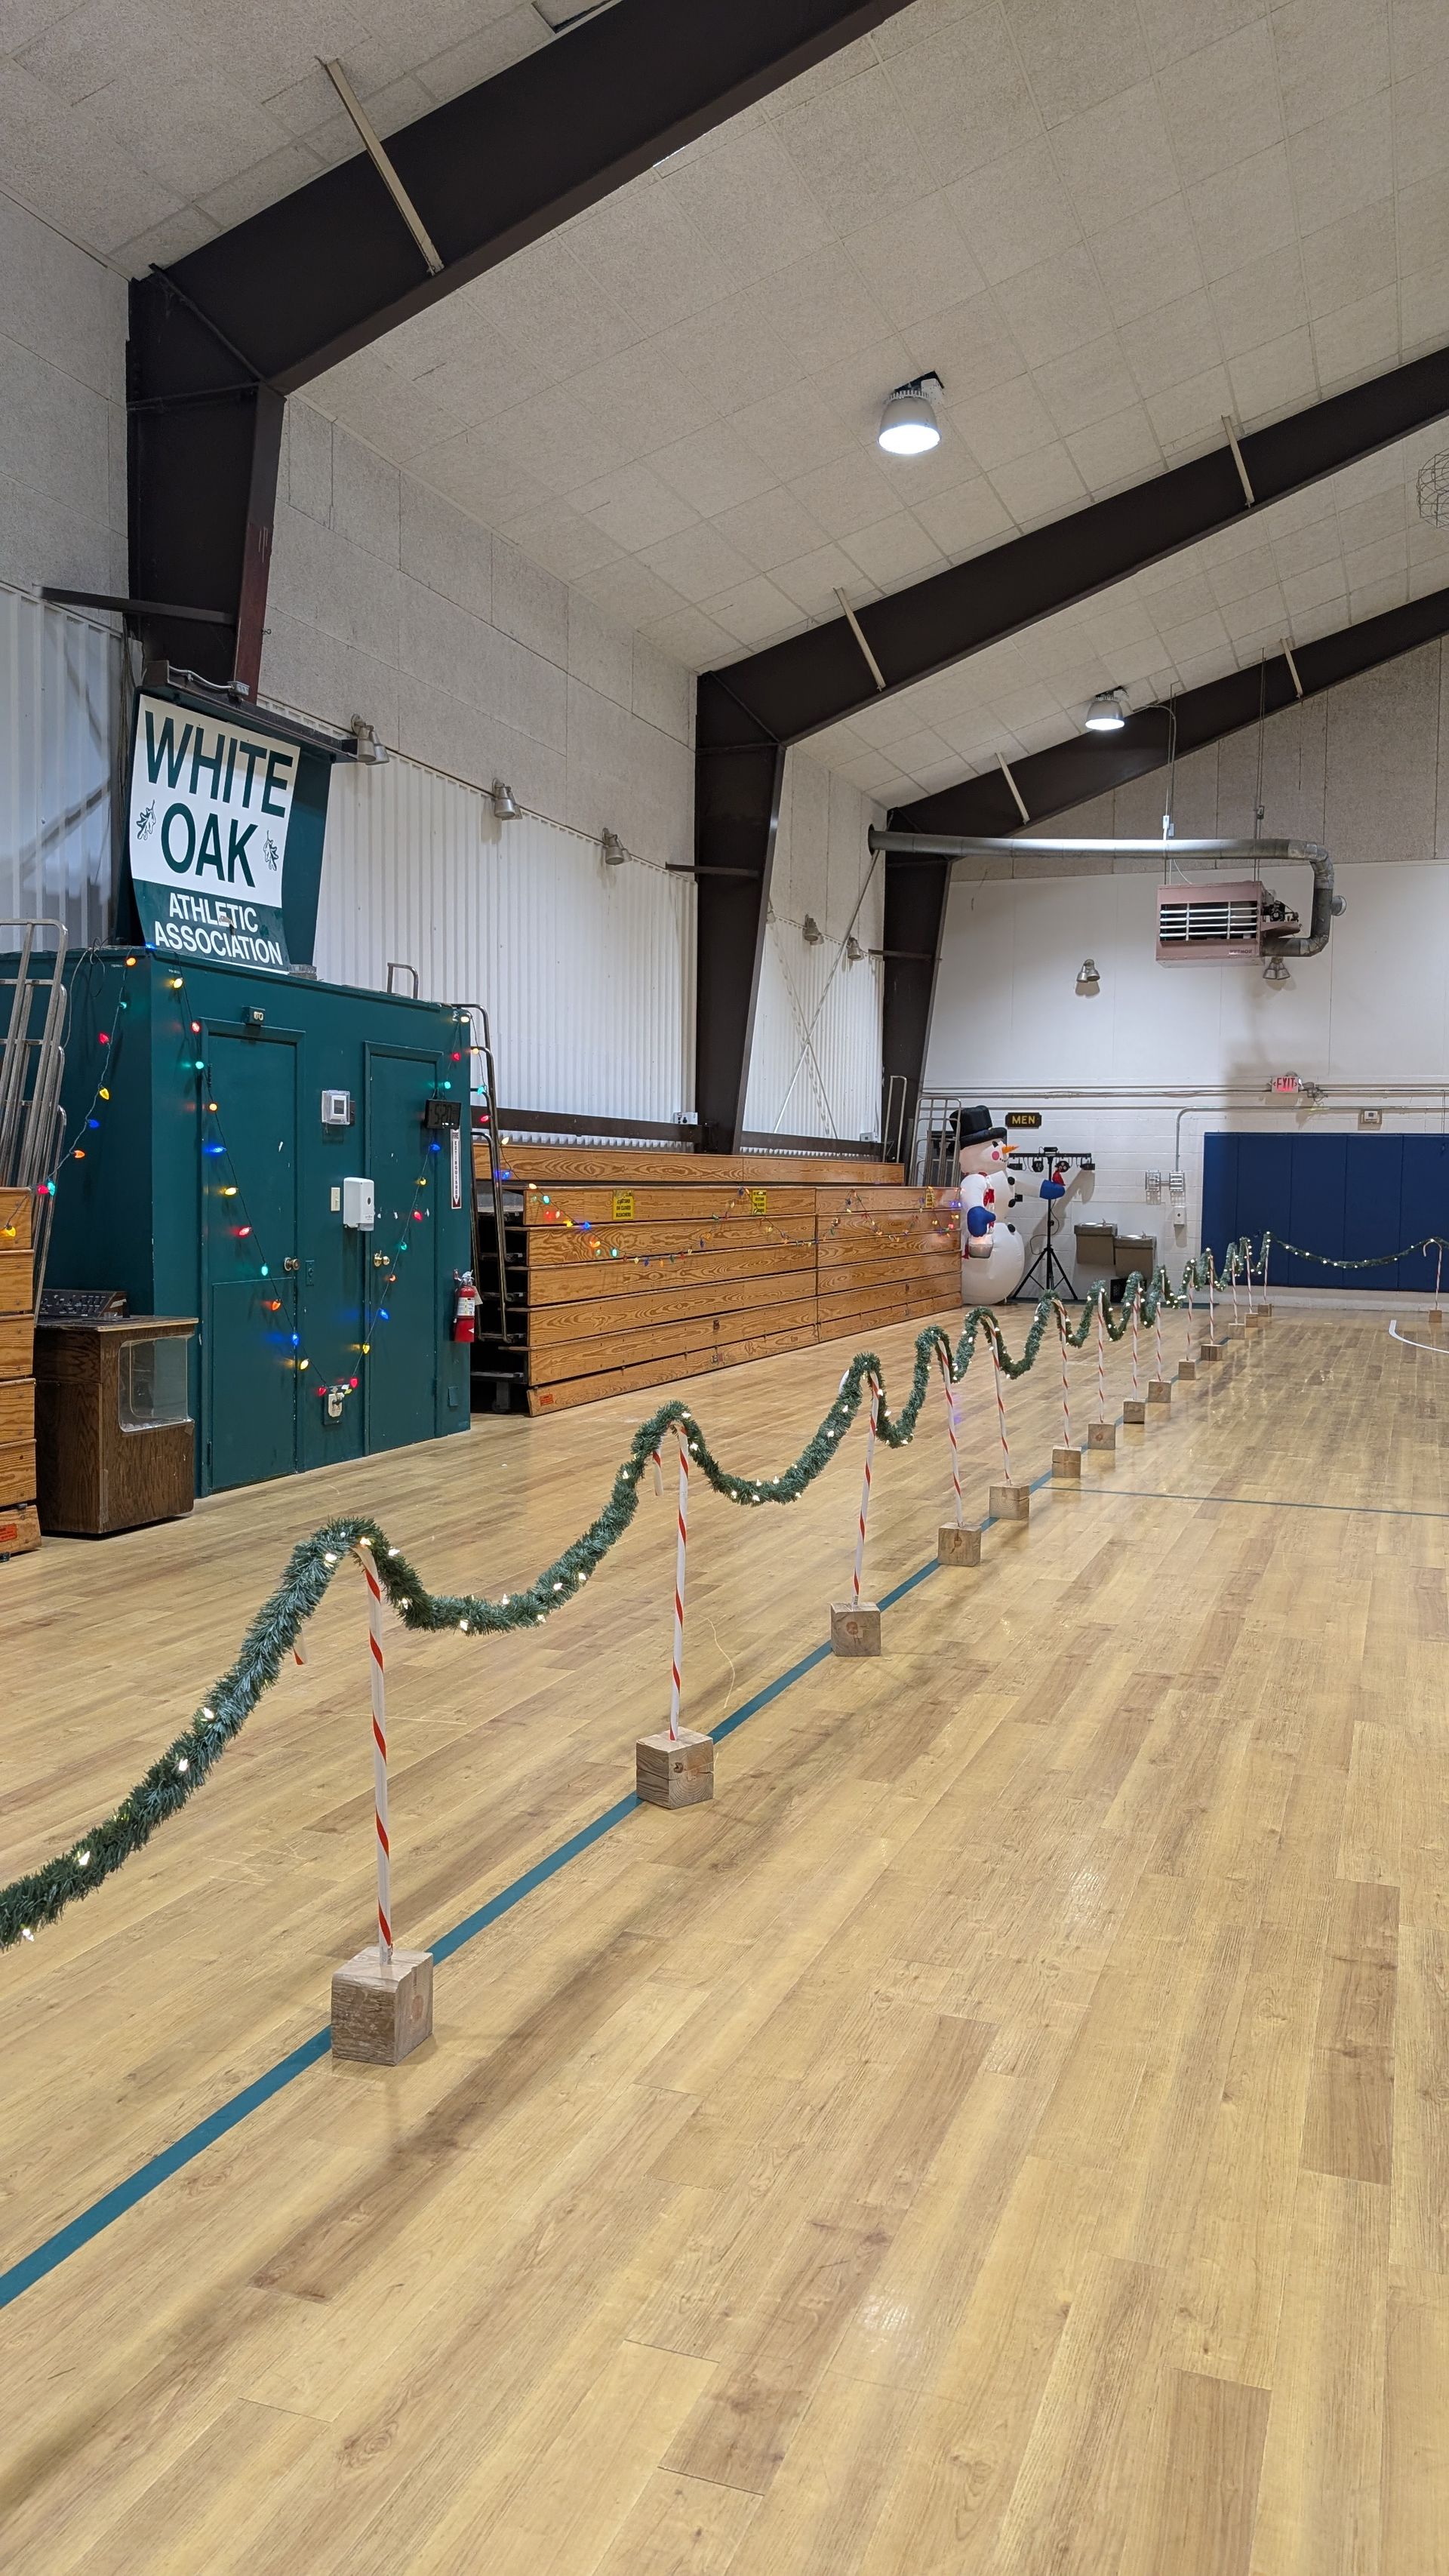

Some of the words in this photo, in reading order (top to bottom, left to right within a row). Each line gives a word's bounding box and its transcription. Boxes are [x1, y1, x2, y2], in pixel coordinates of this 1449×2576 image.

[145, 710, 294, 818] WHITE
[161, 802, 258, 888] OAK
[169, 892, 258, 933] ATHLETIC
[154, 921, 283, 966] ASSOCIATION
[1011, 1115, 1035, 1125] MEN
